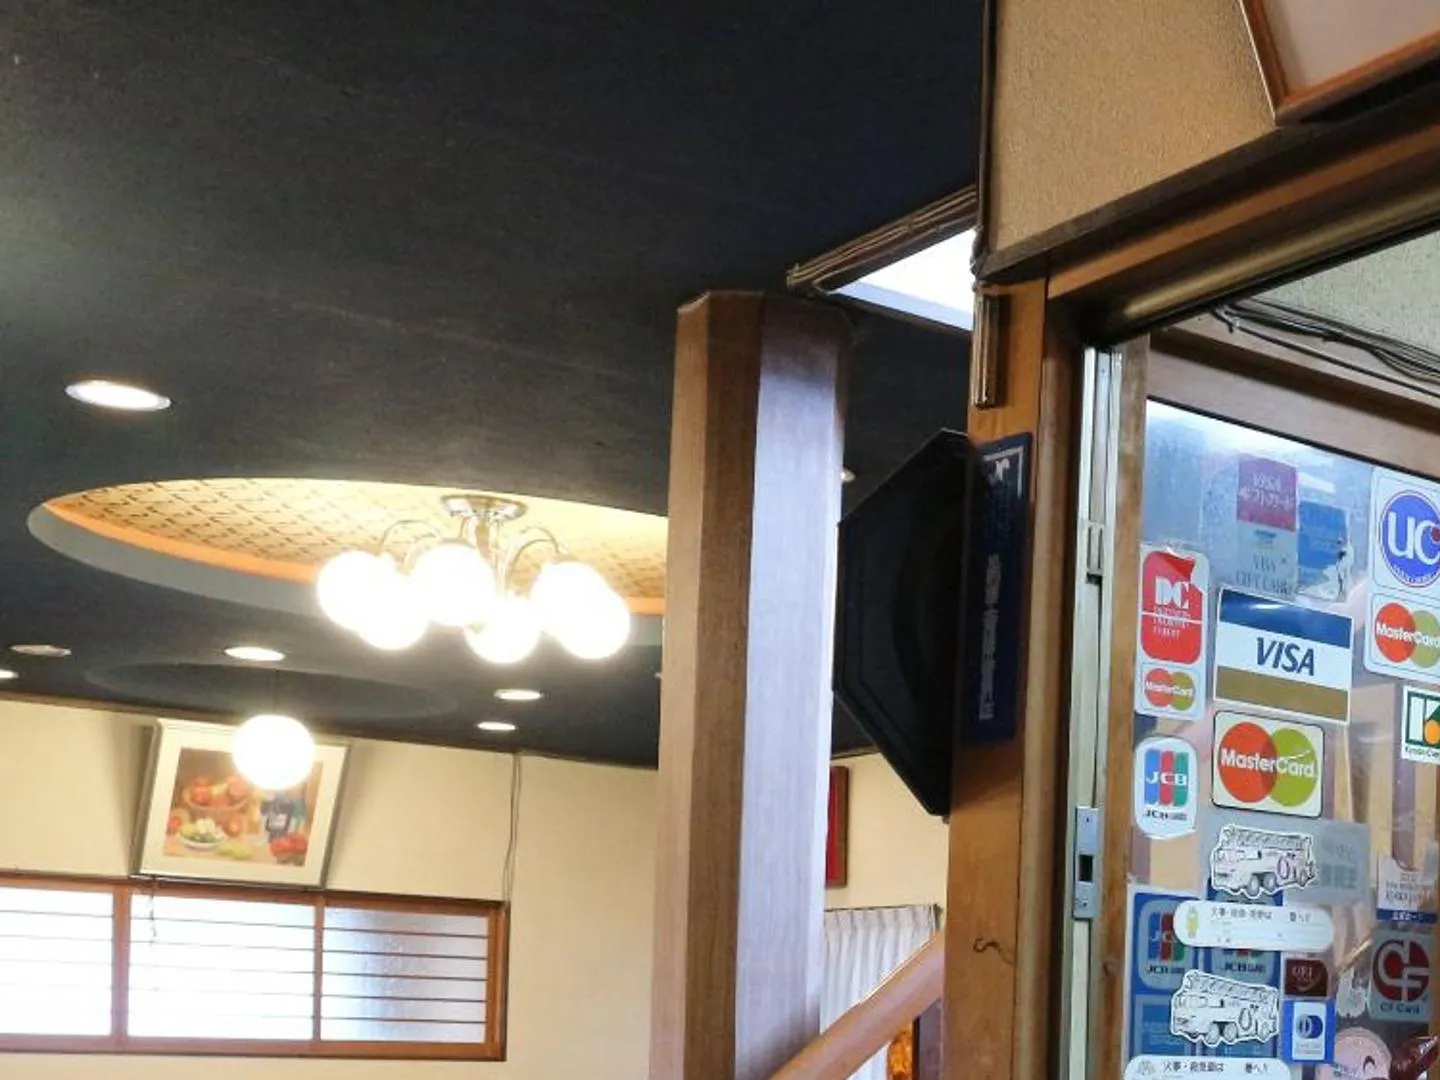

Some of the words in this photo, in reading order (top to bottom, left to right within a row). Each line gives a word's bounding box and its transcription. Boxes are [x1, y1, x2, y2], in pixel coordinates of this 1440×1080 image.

[1376, 620, 1440, 649] MasterCard
[1255, 636, 1315, 677] VISA
[1220, 745, 1314, 778] MasterCard
[1145, 771, 1188, 786] JCB
